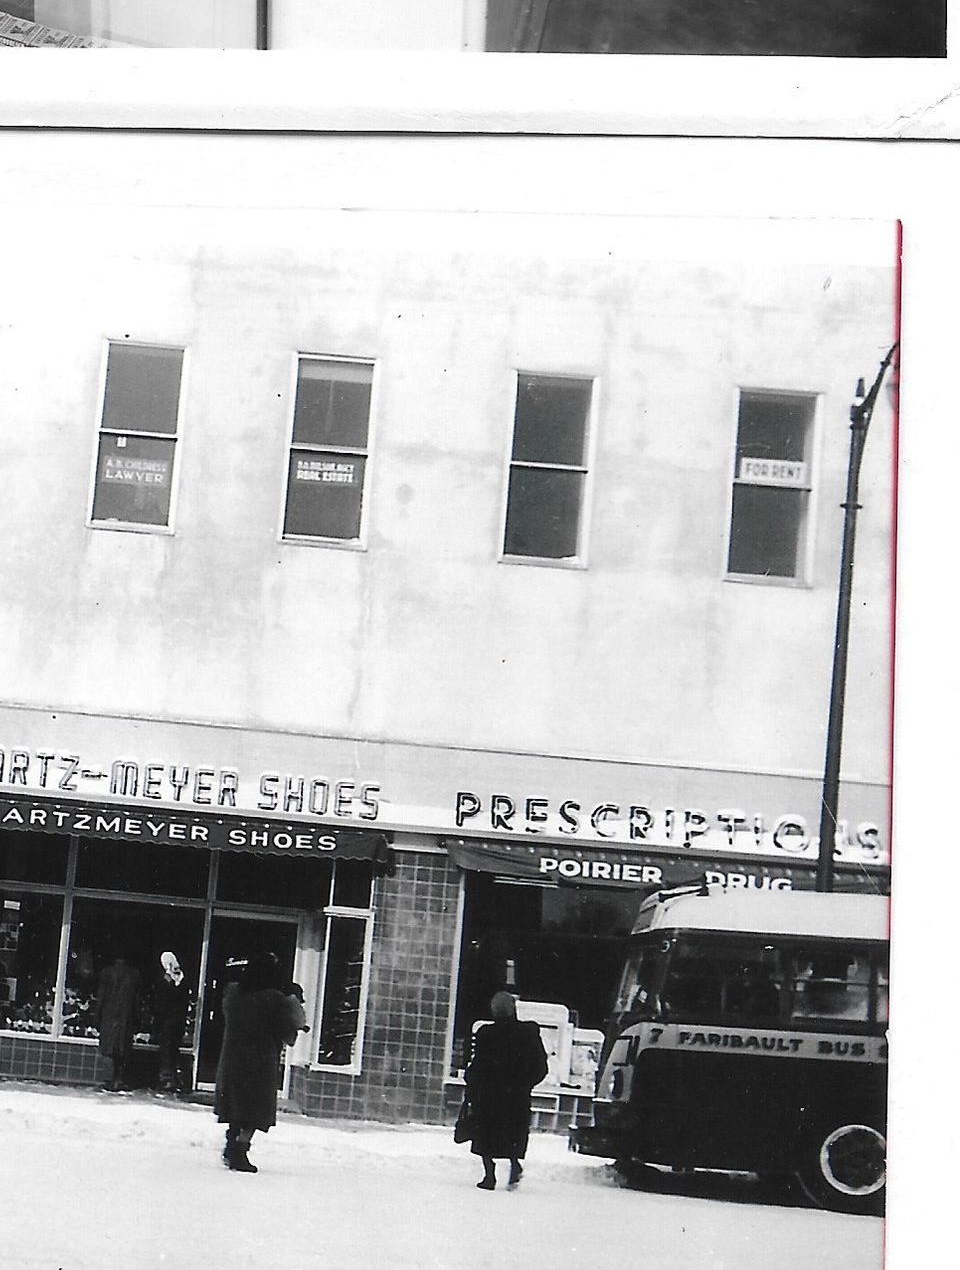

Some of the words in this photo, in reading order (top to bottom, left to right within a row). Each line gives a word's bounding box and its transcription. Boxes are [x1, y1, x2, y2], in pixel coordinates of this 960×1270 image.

[104, 468, 165, 484] LAWYER
[745, 461, 769, 476] FOR
[771, 465, 802, 481] RENT
[257, 773, 381, 821] SHOES
[228, 829, 337, 851] SHOES
[539, 856, 663, 885] POIRIER
[704, 870, 793, 891] DRUG
[648, 1027, 664, 1045] 7
[677, 1031, 804, 1053] FARIBAULT
[817, 1040, 866, 1057] BUS
